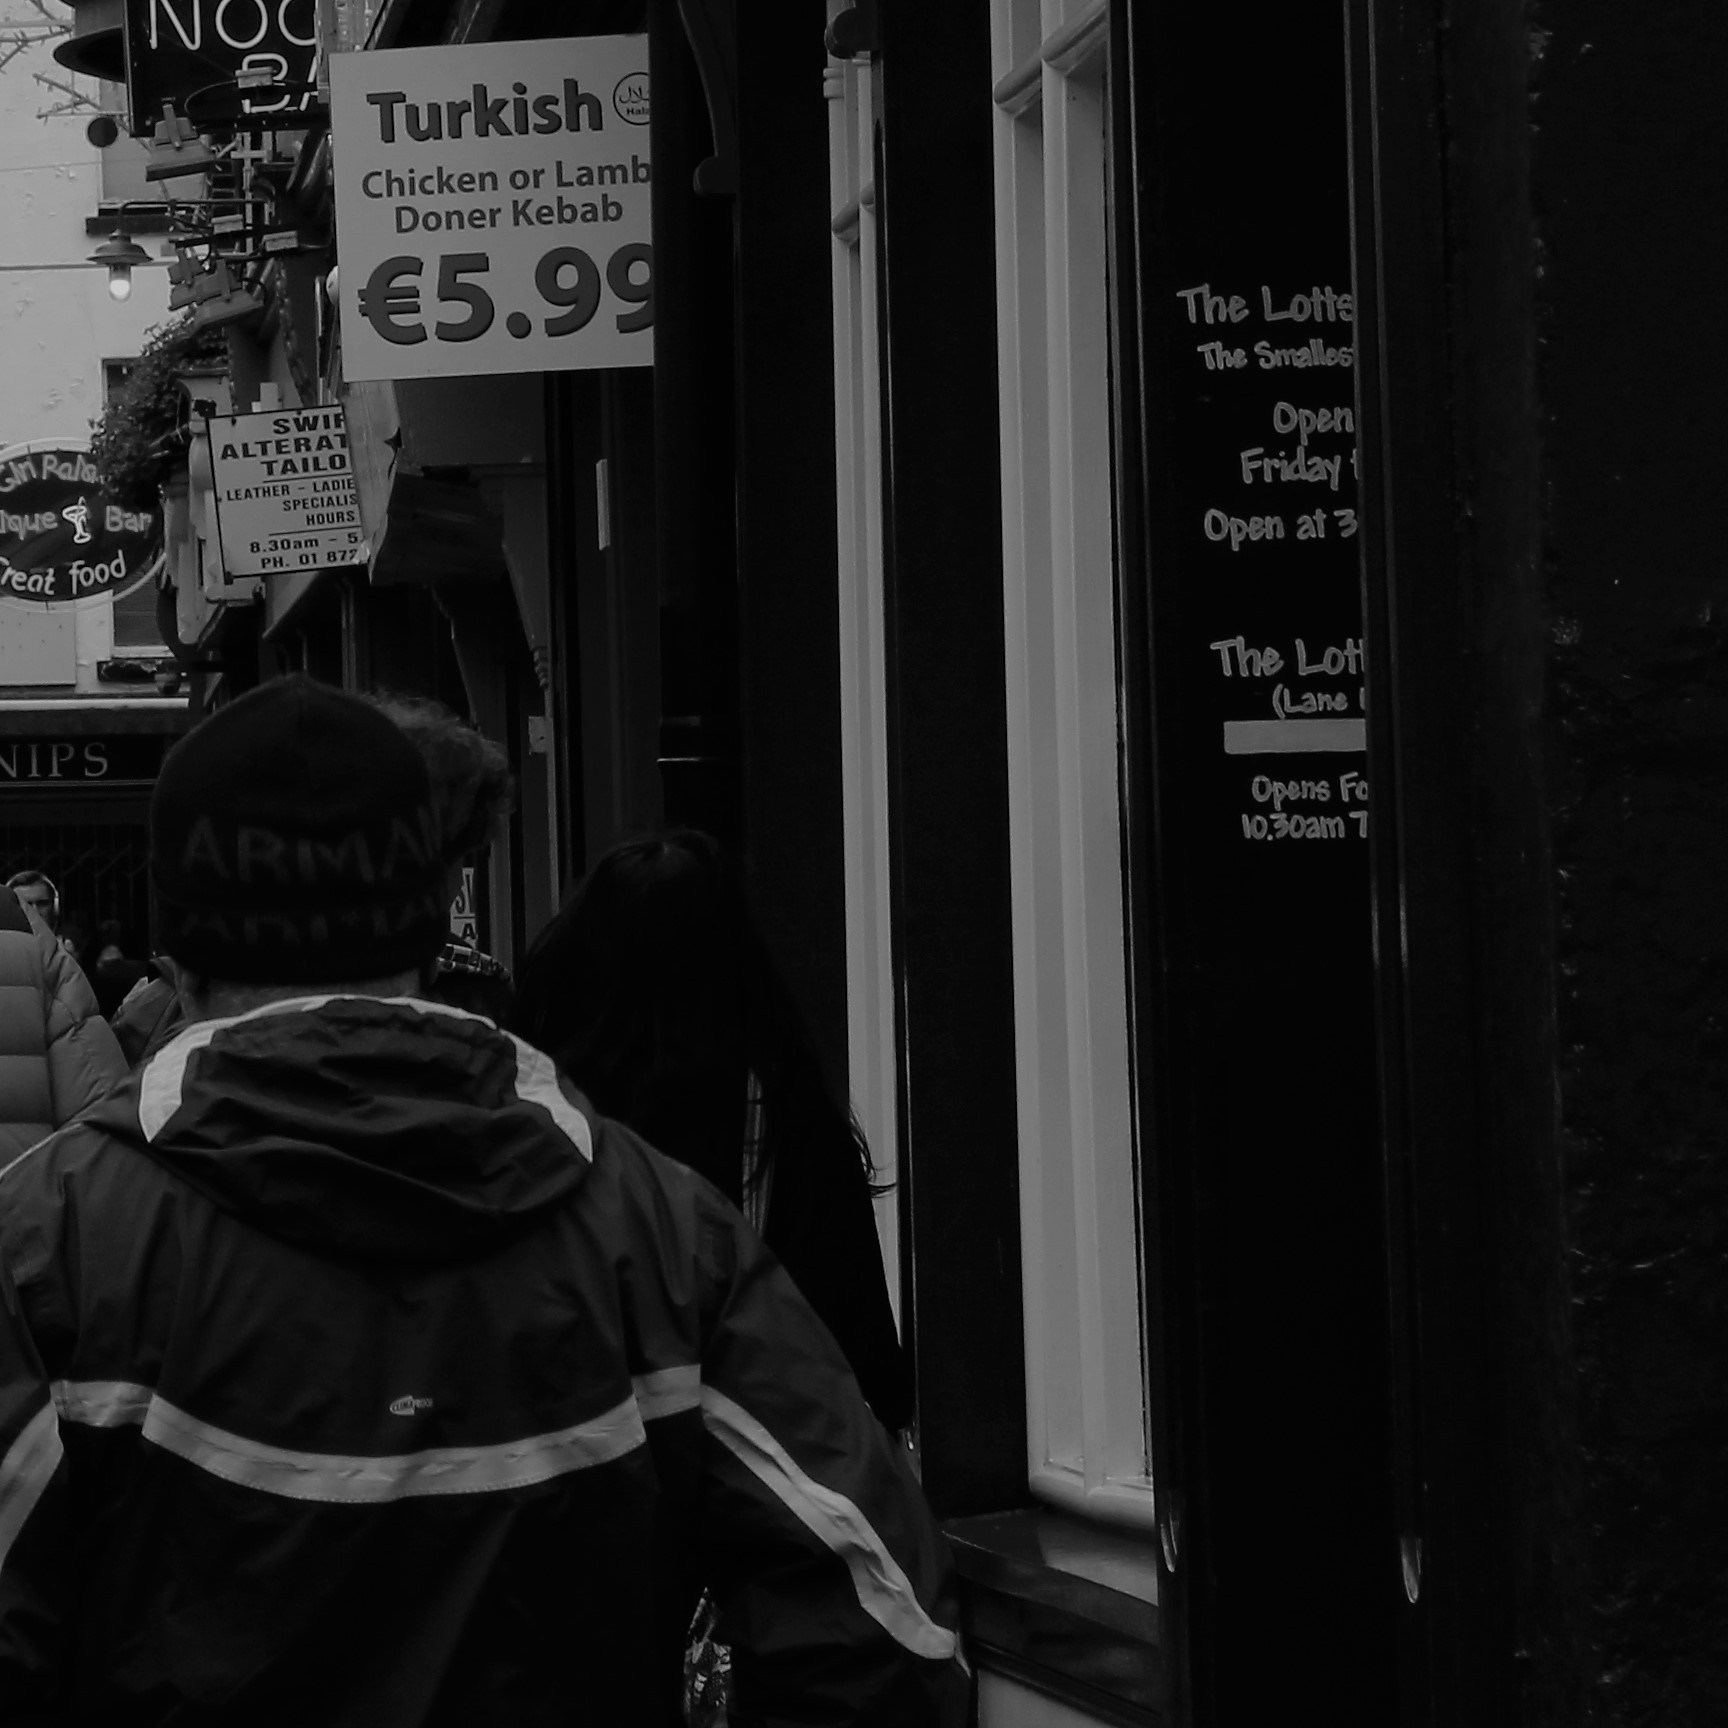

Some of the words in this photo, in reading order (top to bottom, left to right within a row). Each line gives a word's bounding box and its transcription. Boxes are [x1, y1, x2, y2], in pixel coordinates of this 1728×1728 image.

[366, 78, 604, 144] Turkish
[362, 165, 499, 199] Chicken
[509, 167, 545, 191] or
[555, 154, 651, 188] Lamb
[395, 205, 502, 233] Doner
[511, 192, 624, 227] Kebab
[357, 242, 655, 346] €5.99
[1176, 282, 1250, 325] The
[1261, 284, 1353, 322] Lotts
[1196, 340, 1249, 370] The
[1273, 400, 1355, 446] Open
[260, 453, 346, 476] TAILO
[1240, 445, 1342, 492] Friday
[226, 484, 291, 502] LEATHER
[313, 478, 355, 494] LADIE
[283, 493, 359, 512] SPECIALIS
[105, 505, 153, 534] Bar
[306, 510, 355, 526] HOURS
[1203, 507, 1285, 552] Open
[1296, 507, 1327, 541] at
[250, 537, 319, 554] 8.30am
[261, 556, 290, 570] PH.
[299, 553, 318, 566] 01
[68, 548, 127, 596] food
[1210, 635, 1285, 678] The
[1272, 683, 1349, 720] (Lane
[1251, 775, 1332, 812] Opens
[1241, 812, 1345, 841] 10.30am
